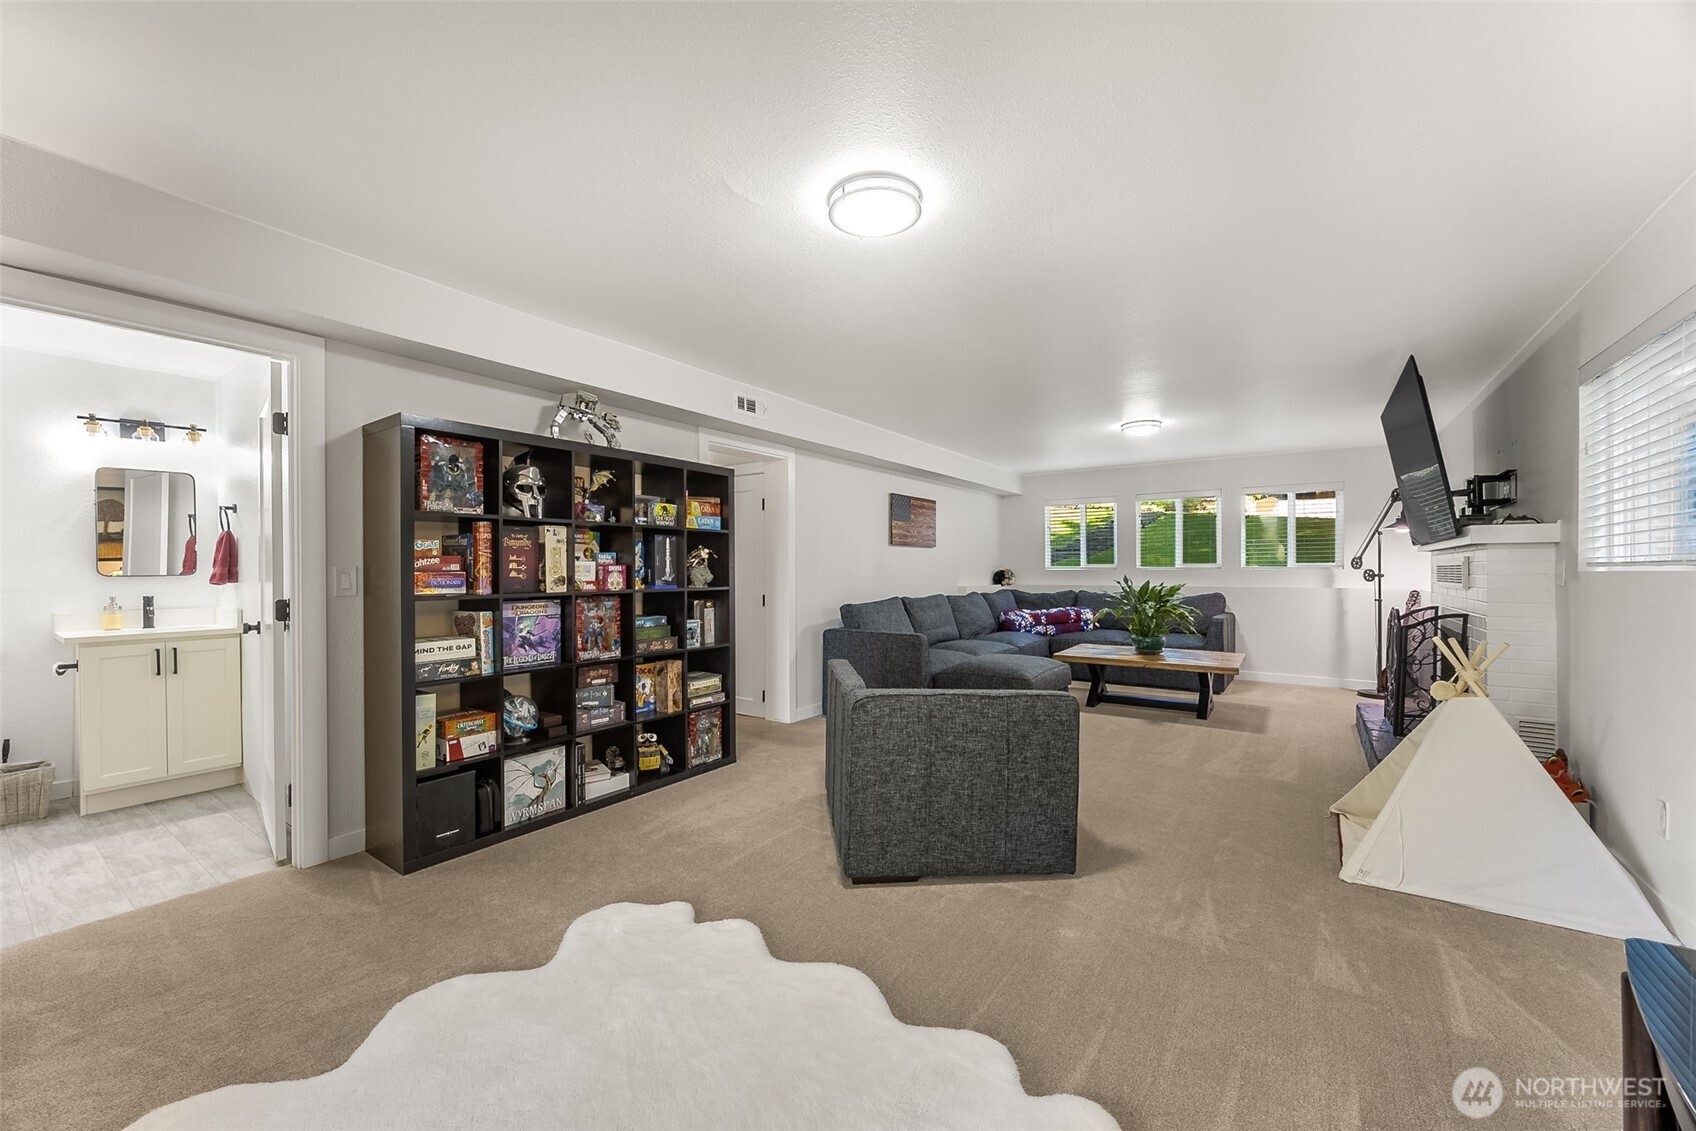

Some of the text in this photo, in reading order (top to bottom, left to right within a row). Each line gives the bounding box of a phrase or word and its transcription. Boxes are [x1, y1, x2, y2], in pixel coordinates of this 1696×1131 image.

[414, 557, 440, 568] ahtzee
[511, 603, 548, 611] DUNGEONS
[508, 796, 563, 822] WYRMSPAN
